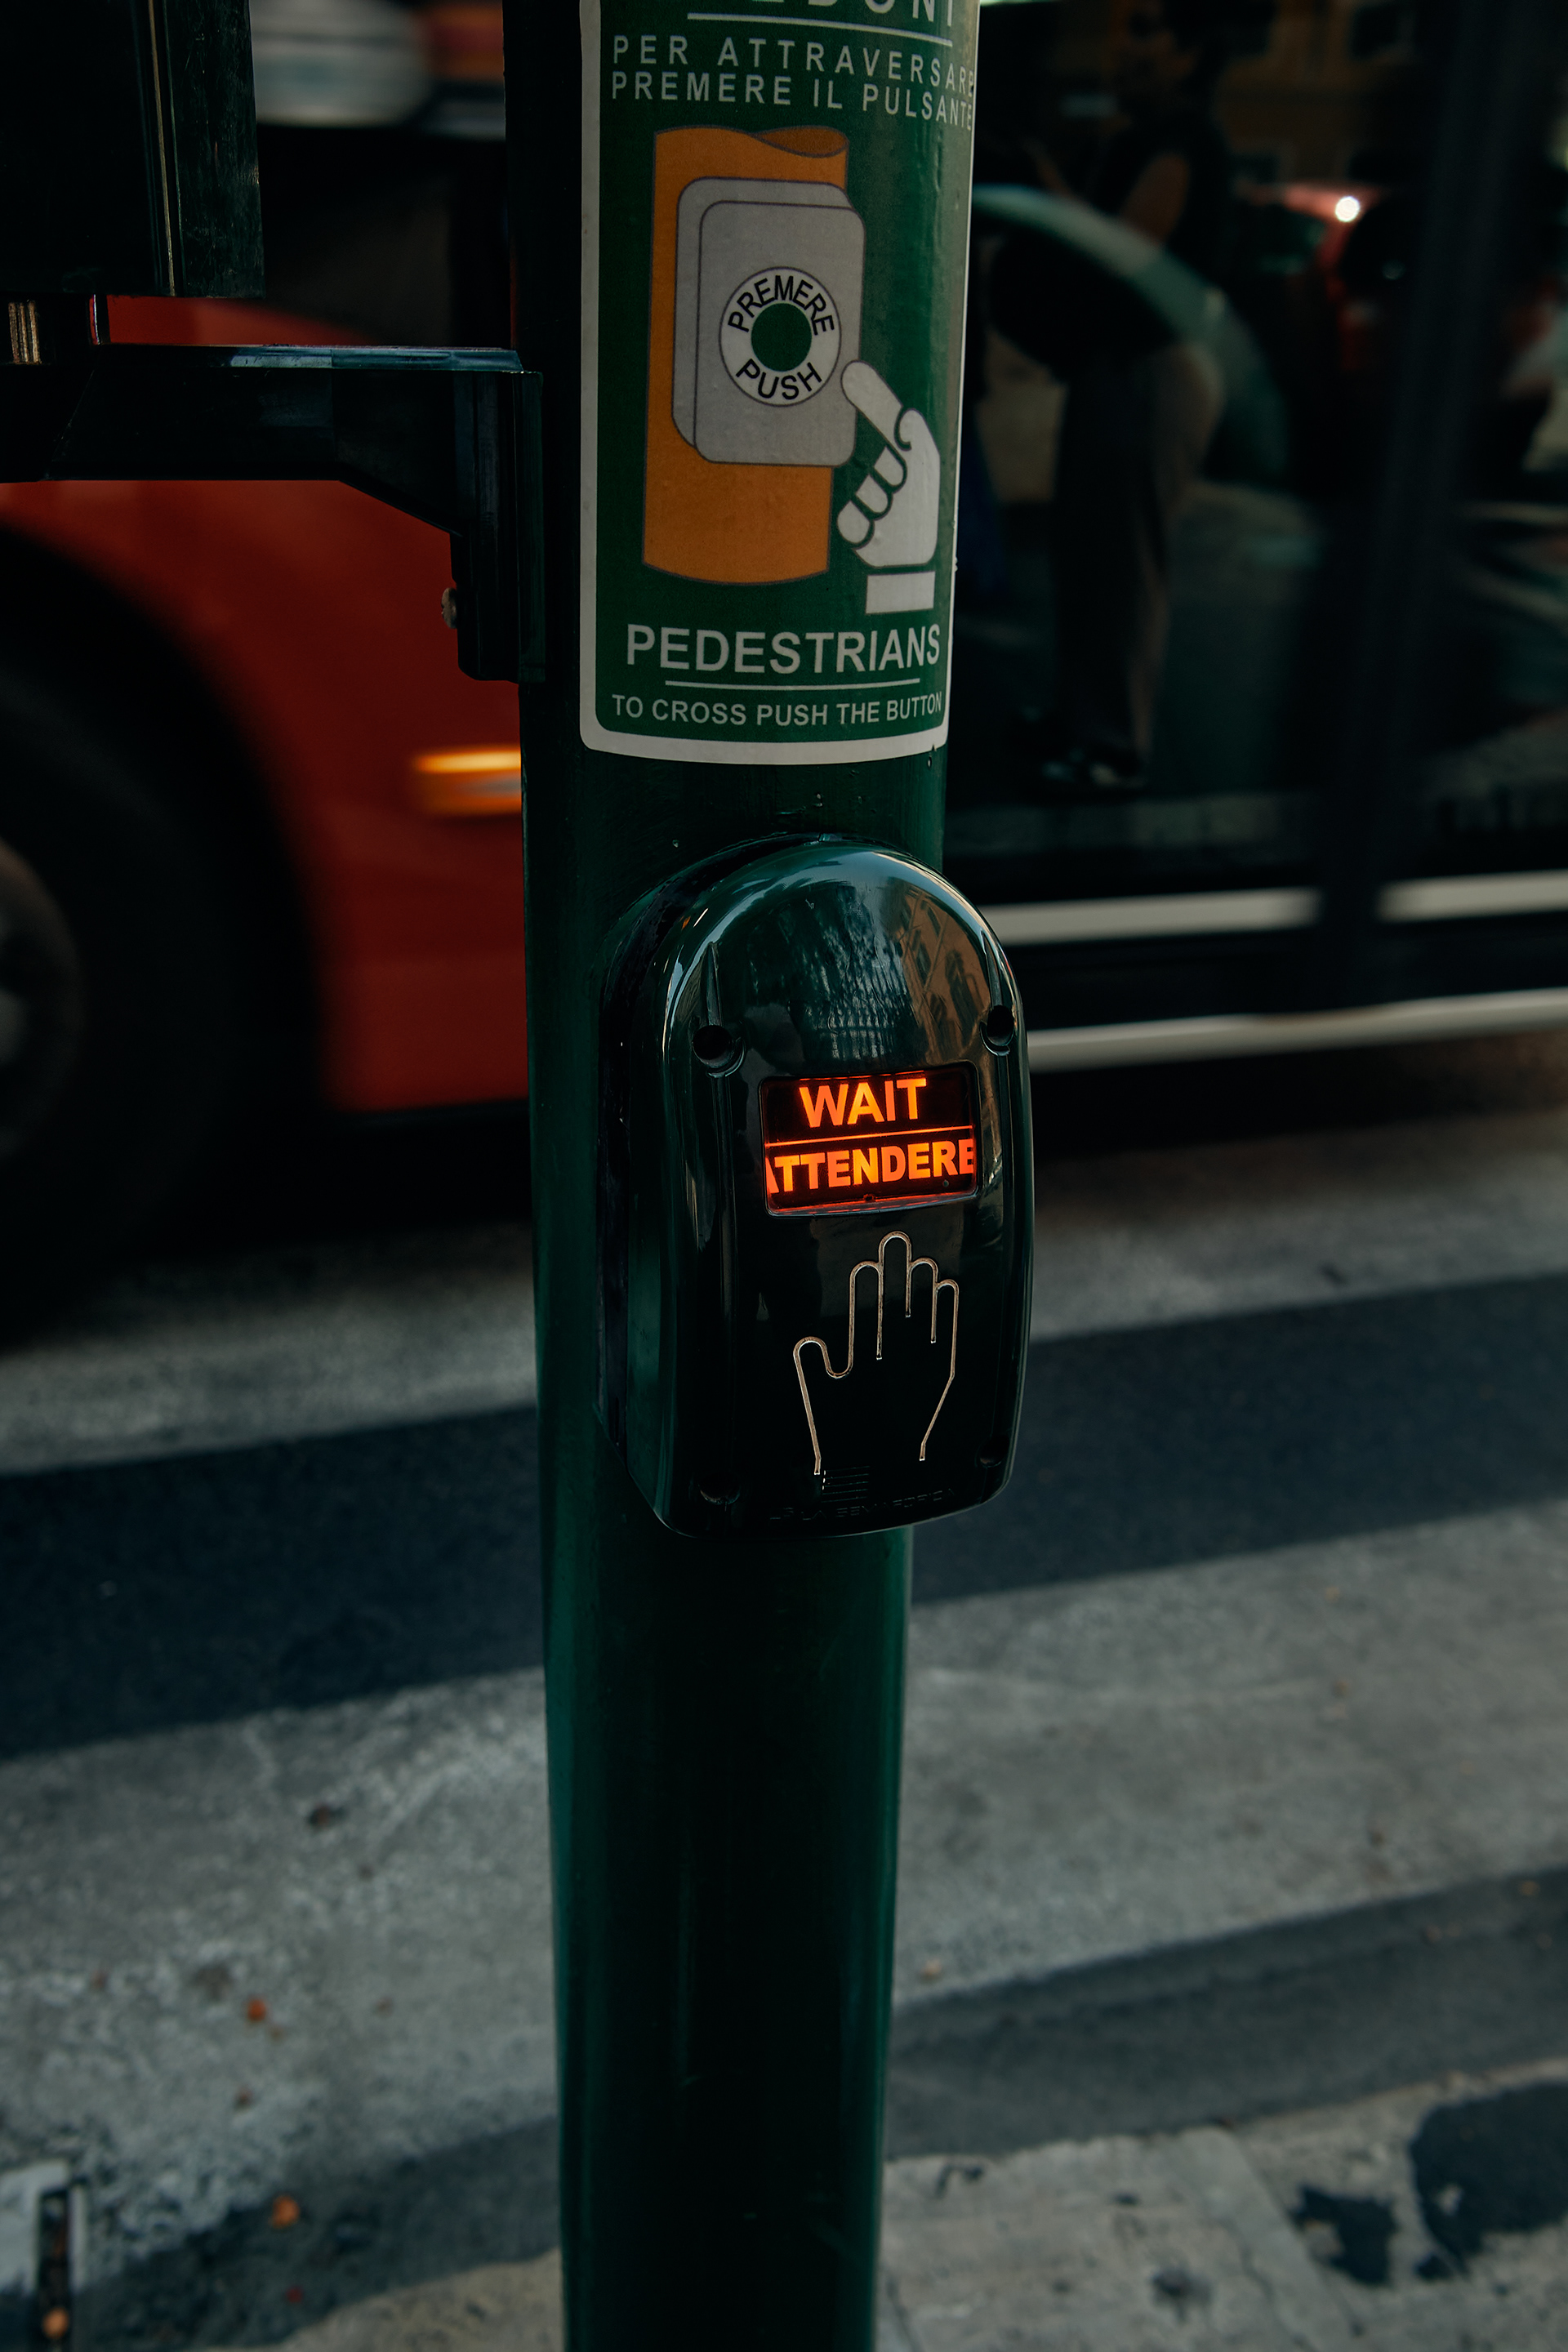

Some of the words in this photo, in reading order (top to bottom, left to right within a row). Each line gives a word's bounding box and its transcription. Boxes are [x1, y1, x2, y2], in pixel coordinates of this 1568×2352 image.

[613, 35, 689, 65] PER
[717, 37, 974, 98] ATTRAVERSARE
[611, 71, 792, 105] PREMERE
[813, 78, 843, 109] IL
[862, 82, 973, 131] PULSANTE
[728, 275, 835, 336] PREMERE
[736, 359, 822, 399] PUSH
[627, 624, 940, 675] PEDESTRIANS
[612, 694, 644, 719] TO
[652, 699, 746, 725] CROSS
[756, 704, 827, 726] PUSH
[835, 702, 880, 724] THE
[885, 691, 942, 720] BUTTON
[799, 1077, 927, 1128] WAIT
